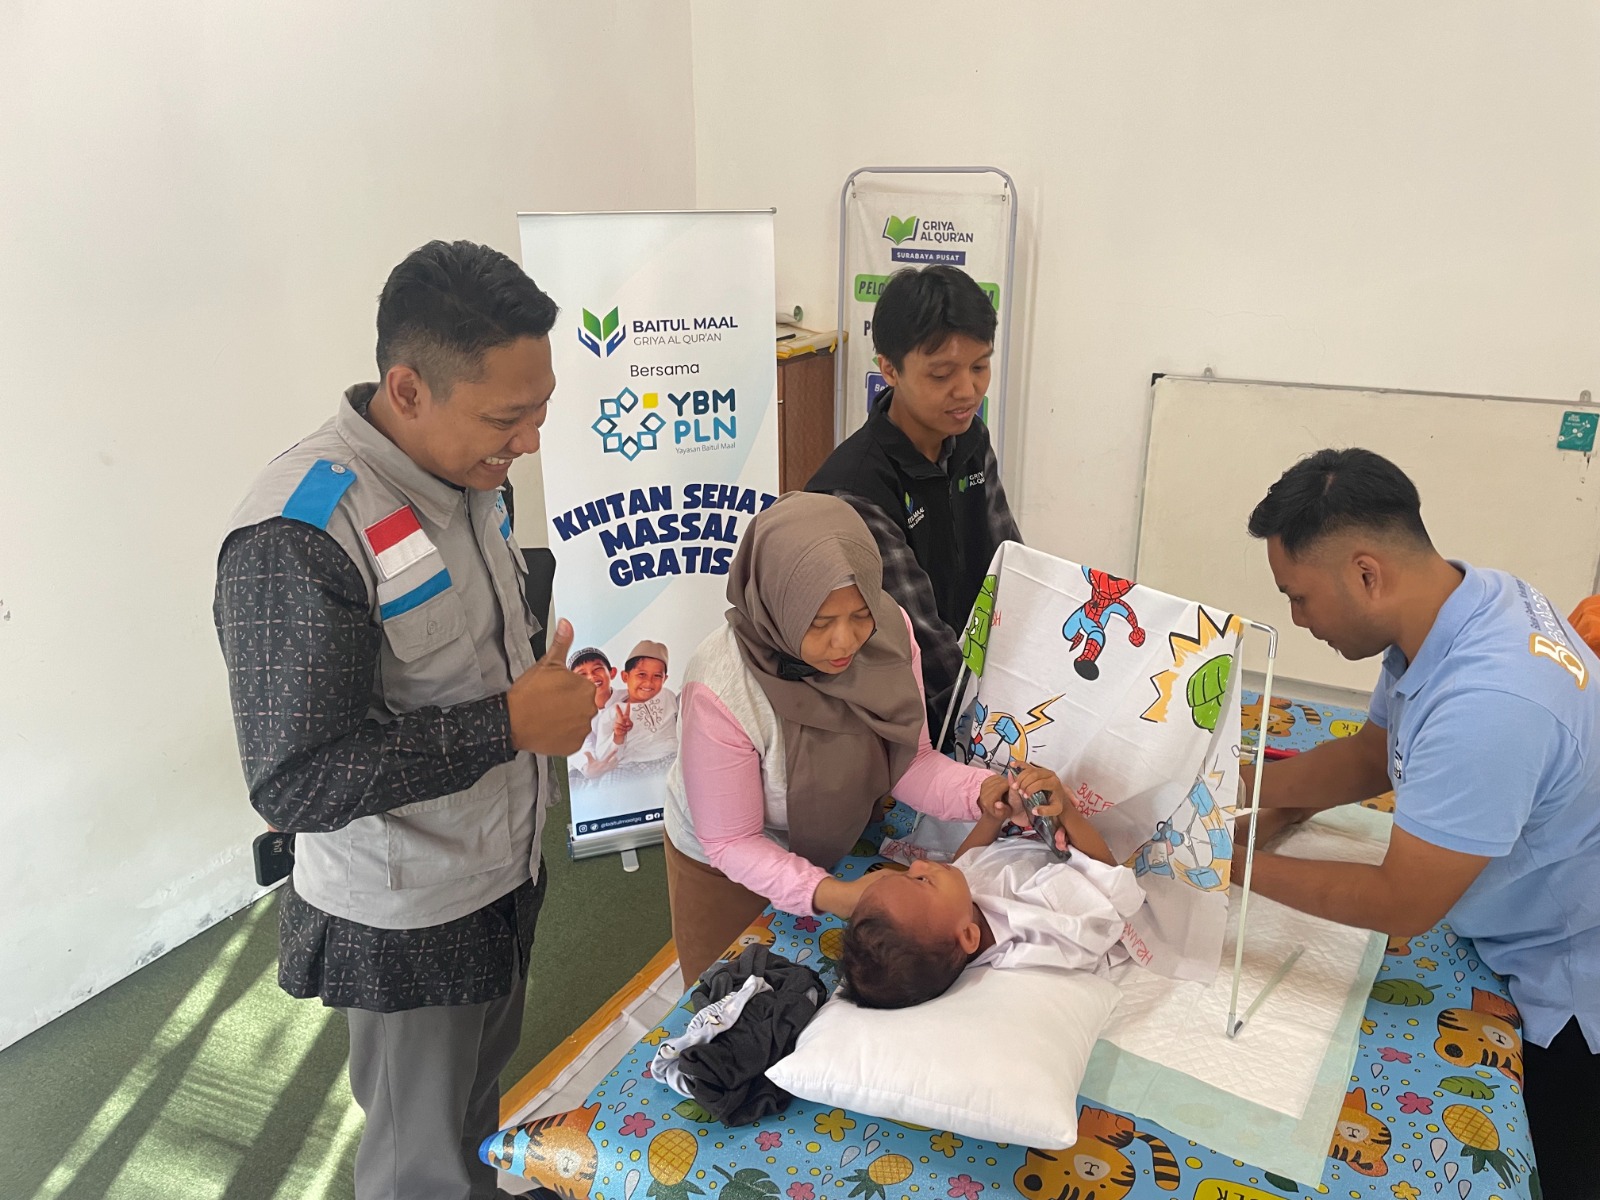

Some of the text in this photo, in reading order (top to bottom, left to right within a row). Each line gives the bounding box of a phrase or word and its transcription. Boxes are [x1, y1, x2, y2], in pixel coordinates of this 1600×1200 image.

[922, 220, 955, 231] GRIYA
[896, 252, 934, 260] SURABAYA
[633, 316, 738, 333] BAITUL MAAL
[633, 333, 722, 346] GRIYA AL QUR'AN
[630, 363, 700, 377] Bersama
[667, 388, 736, 417] YBM
[674, 415, 737, 445] PLN
[675, 441, 736, 455] Yayasan Baitul Maal
[552, 485, 672, 541] KHITAN
[599, 513, 738, 558] MASSAL
[609, 547, 733, 587] GRATIS
